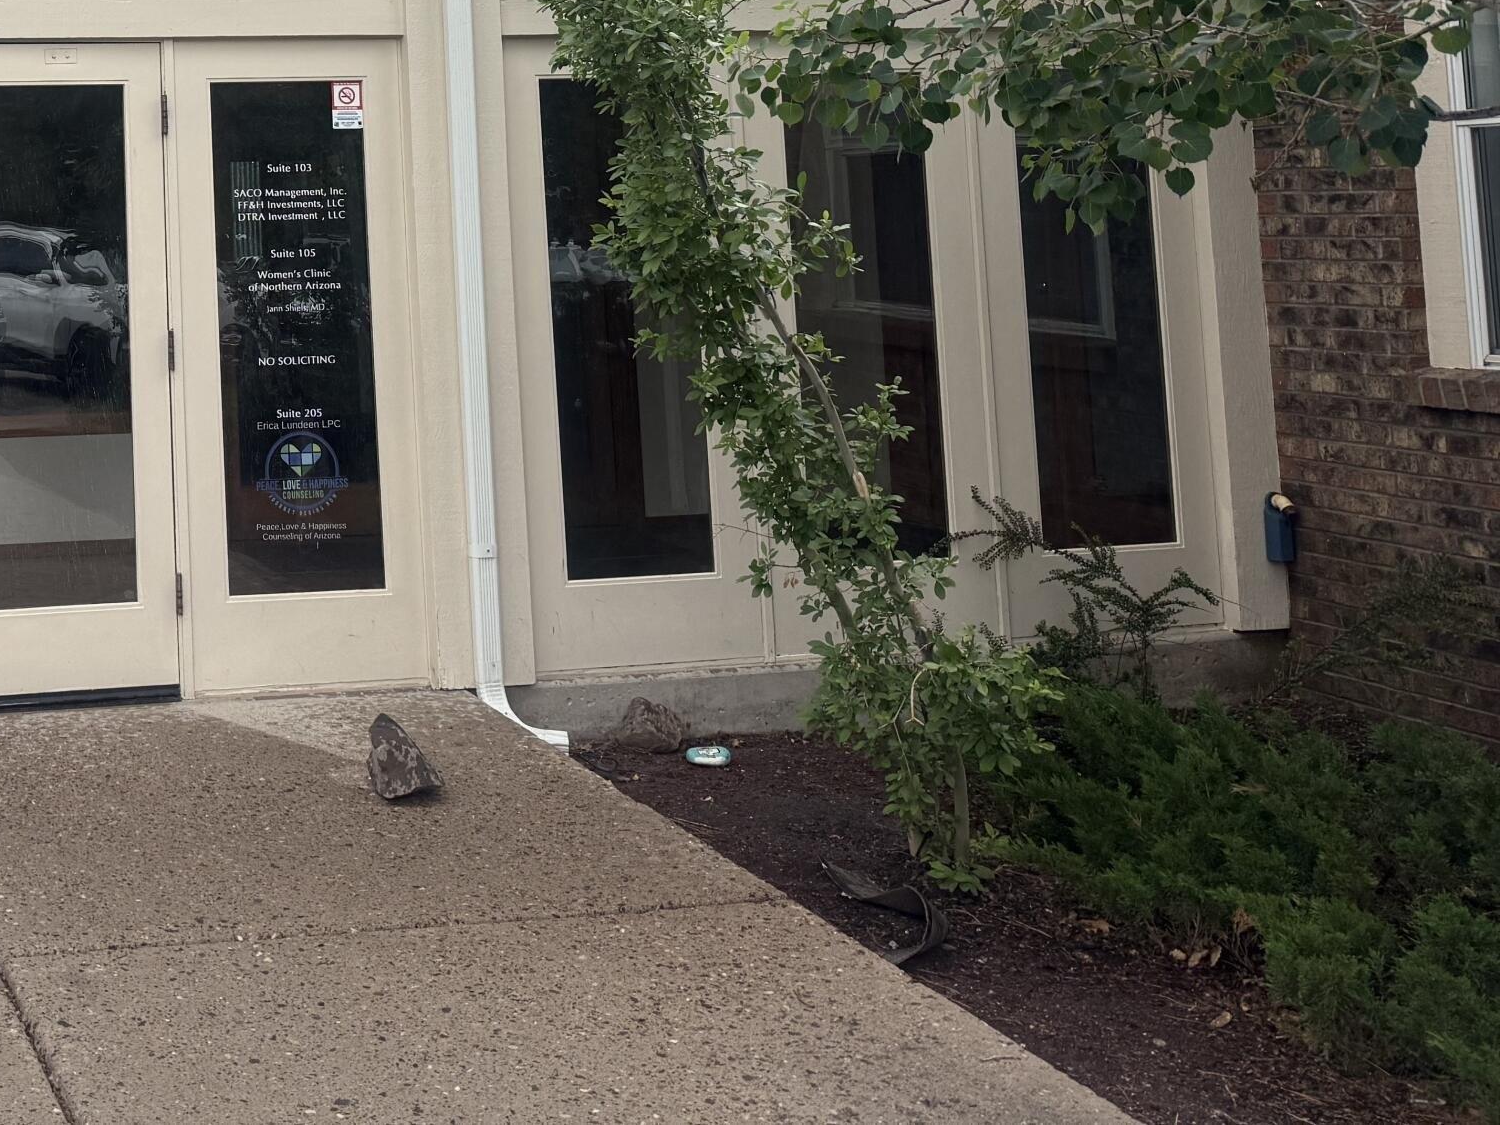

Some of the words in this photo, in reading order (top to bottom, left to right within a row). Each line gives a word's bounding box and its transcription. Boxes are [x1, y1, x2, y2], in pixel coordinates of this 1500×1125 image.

[267, 164, 291, 173] Suite
[295, 163, 312, 172] 103
[234, 189, 261, 197] SACO
[265, 188, 326, 198] Management,
[330, 187, 347, 195] Inc.
[238, 201, 264, 209] FF&H
[268, 200, 323, 208] Investments,
[327, 199, 344, 207] LLC
[238, 213, 265, 221] DTRA
[328, 211, 346, 219] LLC
[271, 249, 295, 258] Suite
[299, 249, 315, 257] 105
[258, 270, 301, 279] Women's
[304, 269, 331, 278] Clinic
[249, 283, 258, 291] of
[261, 283, 302, 291] Northern
[305, 282, 341, 290] Arizona
[267, 305, 283, 313] Jann
[259, 357, 275, 366] NO
[278, 355, 335, 365] SOLICITING
[277, 409, 301, 418] Suite
[305, 409, 322, 417] 205
[257, 421, 279, 430] Erica
[282, 420, 319, 429] Lundeen
[322, 420, 341, 428] LPC
[283, 480, 301, 490] LOVE
[309, 478, 349, 489] HAPPINESS
[283, 490, 324, 499] COUNSELING
[309, 522, 347, 531] Happiness
[263, 533, 303, 541] Counseling
